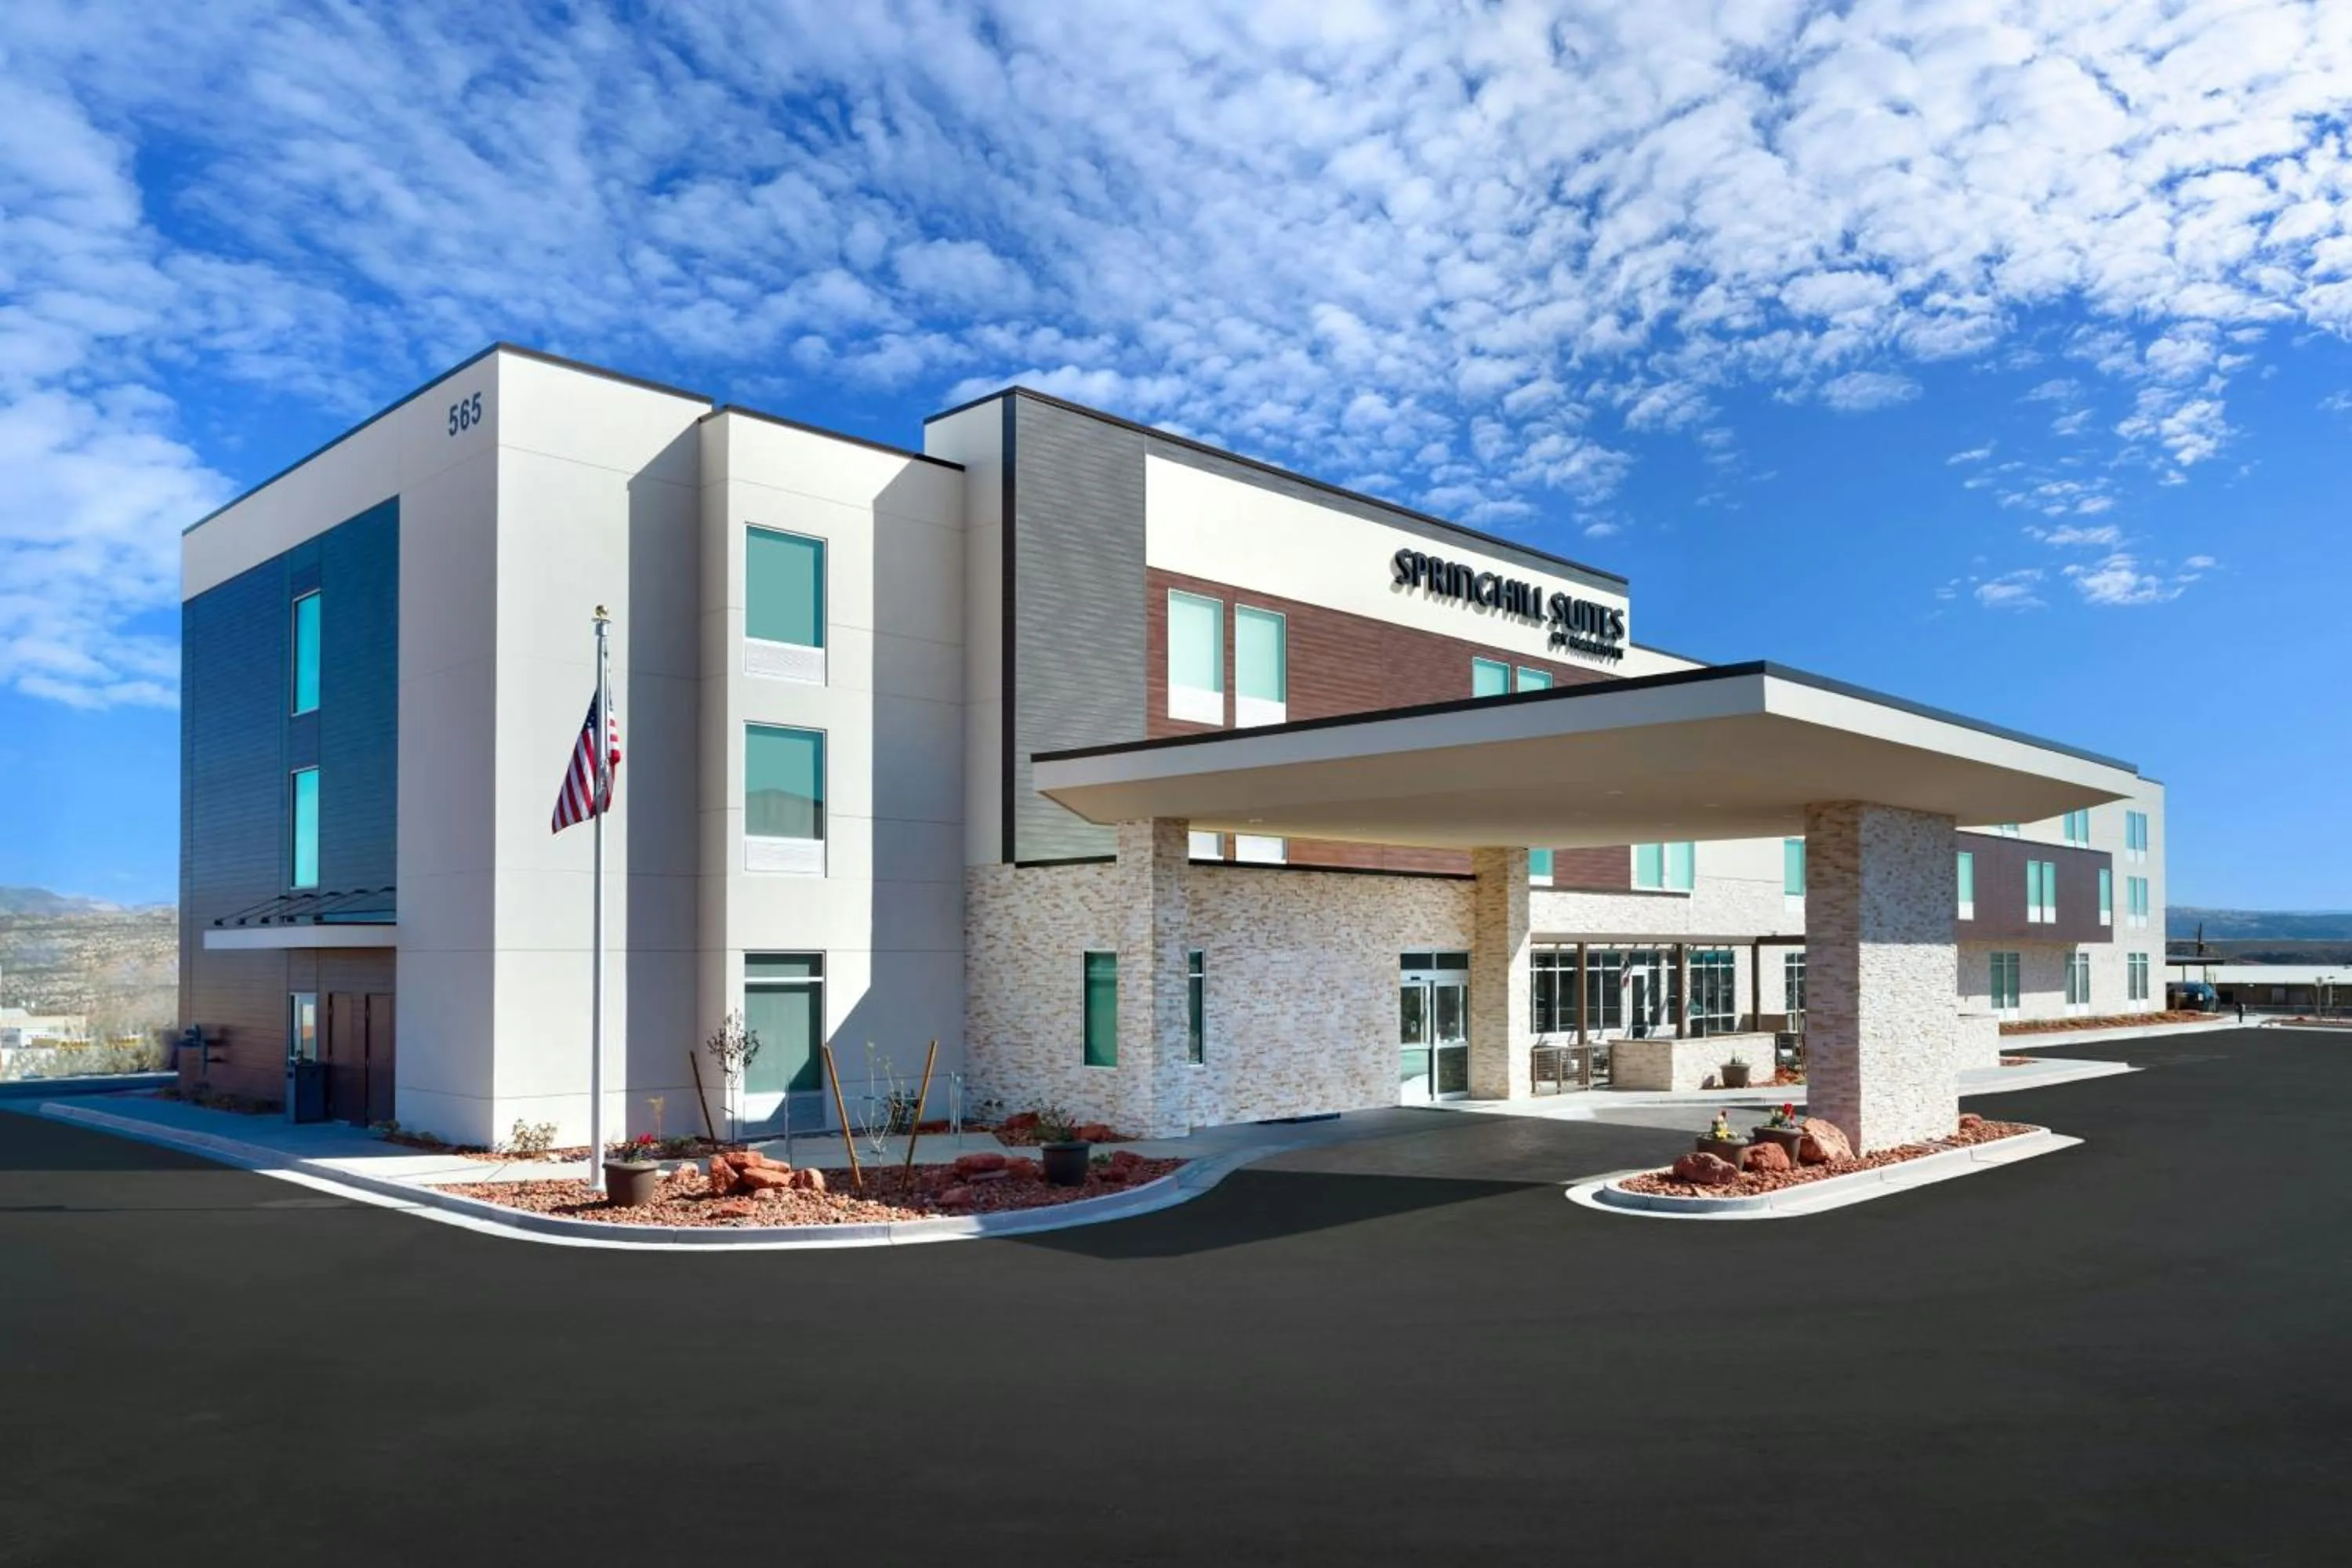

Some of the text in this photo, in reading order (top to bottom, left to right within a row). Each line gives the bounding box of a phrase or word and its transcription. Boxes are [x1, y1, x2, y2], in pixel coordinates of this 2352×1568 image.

[448, 391, 482, 437] 565
[1393, 548, 1625, 640] SPRINGHILL SUITES
